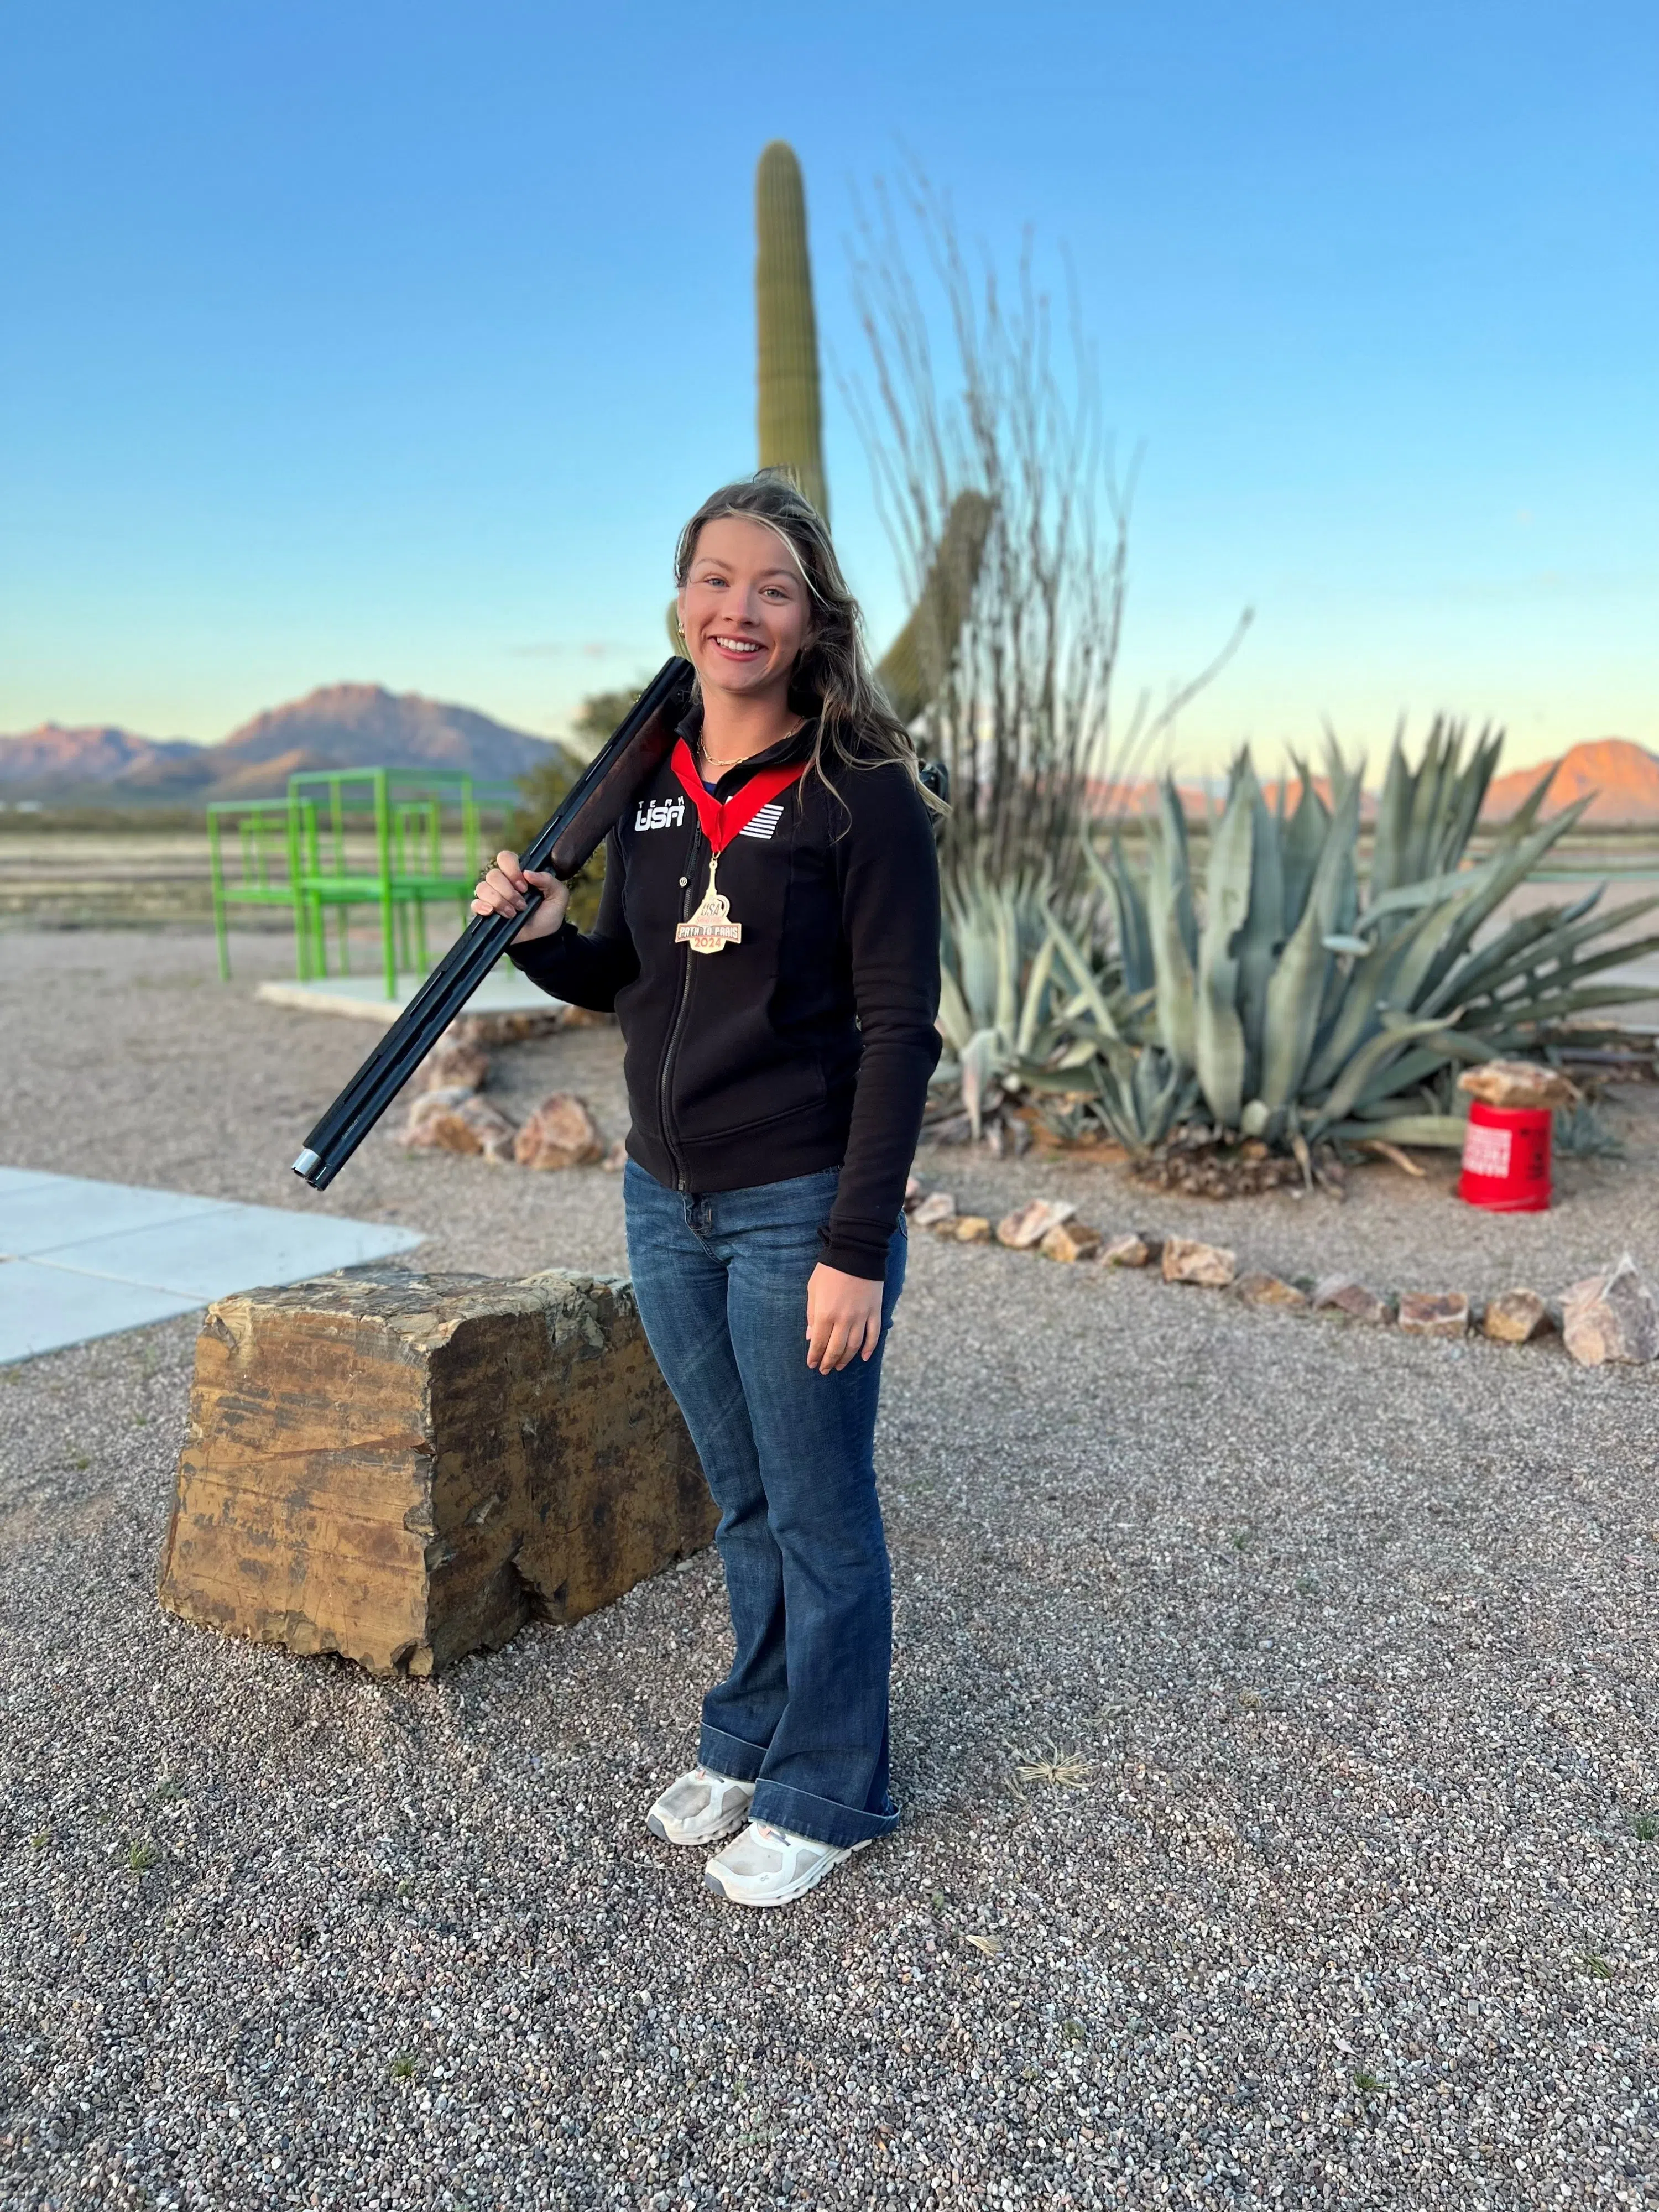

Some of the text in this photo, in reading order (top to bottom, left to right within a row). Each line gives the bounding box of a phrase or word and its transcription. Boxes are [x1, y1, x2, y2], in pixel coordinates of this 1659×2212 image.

[638, 795, 684, 809] TEAM
[634, 805, 685, 831] USA
[701, 903, 721, 916] USA
[679, 927, 738, 938] PATH TO PARIS
[694, 937, 721, 947] 2024
